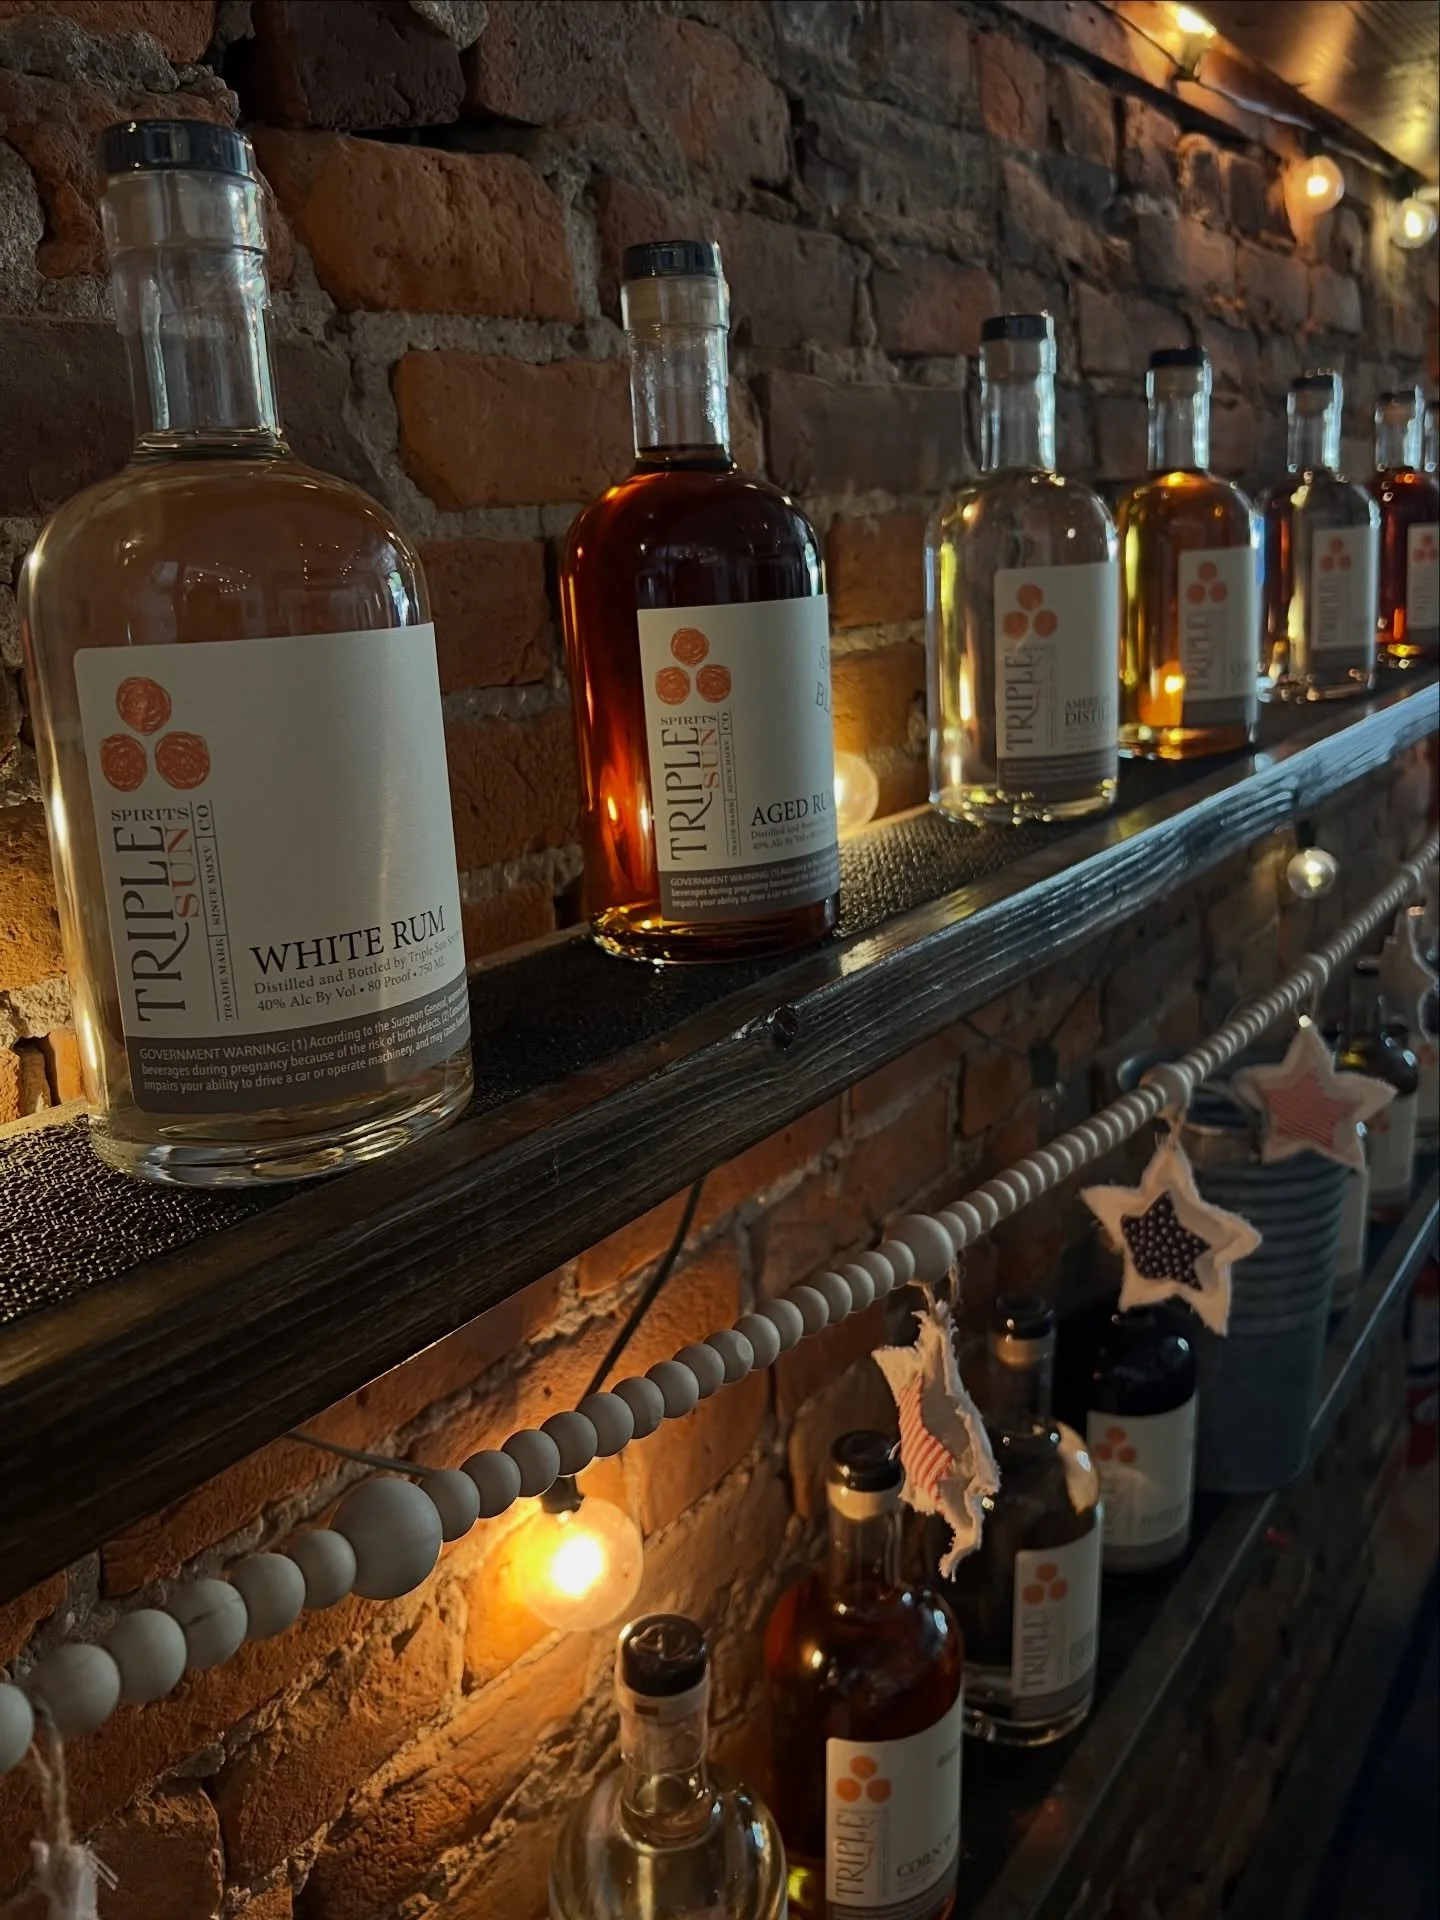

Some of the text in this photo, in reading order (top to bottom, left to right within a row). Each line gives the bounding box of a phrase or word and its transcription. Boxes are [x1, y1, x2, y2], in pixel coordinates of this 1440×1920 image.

[660, 715, 718, 726] SPIRITS
[1004, 655, 1041, 751] TRIPLE
[700, 728, 720, 790] SUN
[111, 808, 189, 822] SPIRITS
[196, 804, 210, 831] CO
[661, 727, 713, 861] TRIPLE
[751, 798, 808, 827] AGED
[164, 825, 200, 918] SUN
[203, 844, 221, 926] SINCE MMXV
[670, 875, 728, 887] GOVERNMENT
[113, 825, 189, 1022] TRIPLE
[699, 898, 716, 909] your
[249, 905, 446, 975] WHITE RUM
[215, 938, 233, 1021] TRADE MARK
[254, 974, 314, 995] Distilled
[319, 969, 344, 985] and
[348, 957, 391, 980] Bottled
[393, 957, 407, 970] by
[409, 944, 433, 964] Triple
[257, 996, 286, 1012] 40%
[290, 993, 311, 1008] Alc
[316, 991, 332, 1005] By
[335, 984, 356, 998] Vol
[368, 979, 381, 991] 80
[384, 968, 411, 988] Proof
[139, 1047, 220, 1061] GOVERNMENT
[222, 1040, 290, 1059] WARNING:
[291, 1035, 308, 1052] (1)
[309, 1029, 361, 1049] According
[363, 1025, 373, 1036] to
[374, 1021, 390, 1034] the
[391, 1010, 424, 1029] Surgeon
[141, 1062, 191, 1079] beverages
[192, 1063, 228, 1078] during
[230, 1059, 288, 1076] pregnancy
[290, 1049, 334, 1067] because
[337, 1045, 348, 1059] of
[349, 1043, 367, 1057] the
[368, 1036, 385, 1051] risk
[386, 1032, 396, 1046] of
[397, 1025, 417, 1042] birth
[143, 1079, 179, 1093] impairs
[180, 1081, 204, 1095] your
[205, 1078, 240, 1093] ability
[241, 1078, 253, 1089] to
[254, 1074, 284, 1087] drive
[285, 1073, 292, 1083] a
[295, 1070, 311, 1081] car
[313, 1067, 325, 1079] or
[327, 1058, 367, 1077] operate
[368, 1043, 415, 1067] machinery,
[415, 1035, 430, 1050] and
[430, 1031, 443, 1046] may
[835, 1813, 876, 1898] TRIPLE
